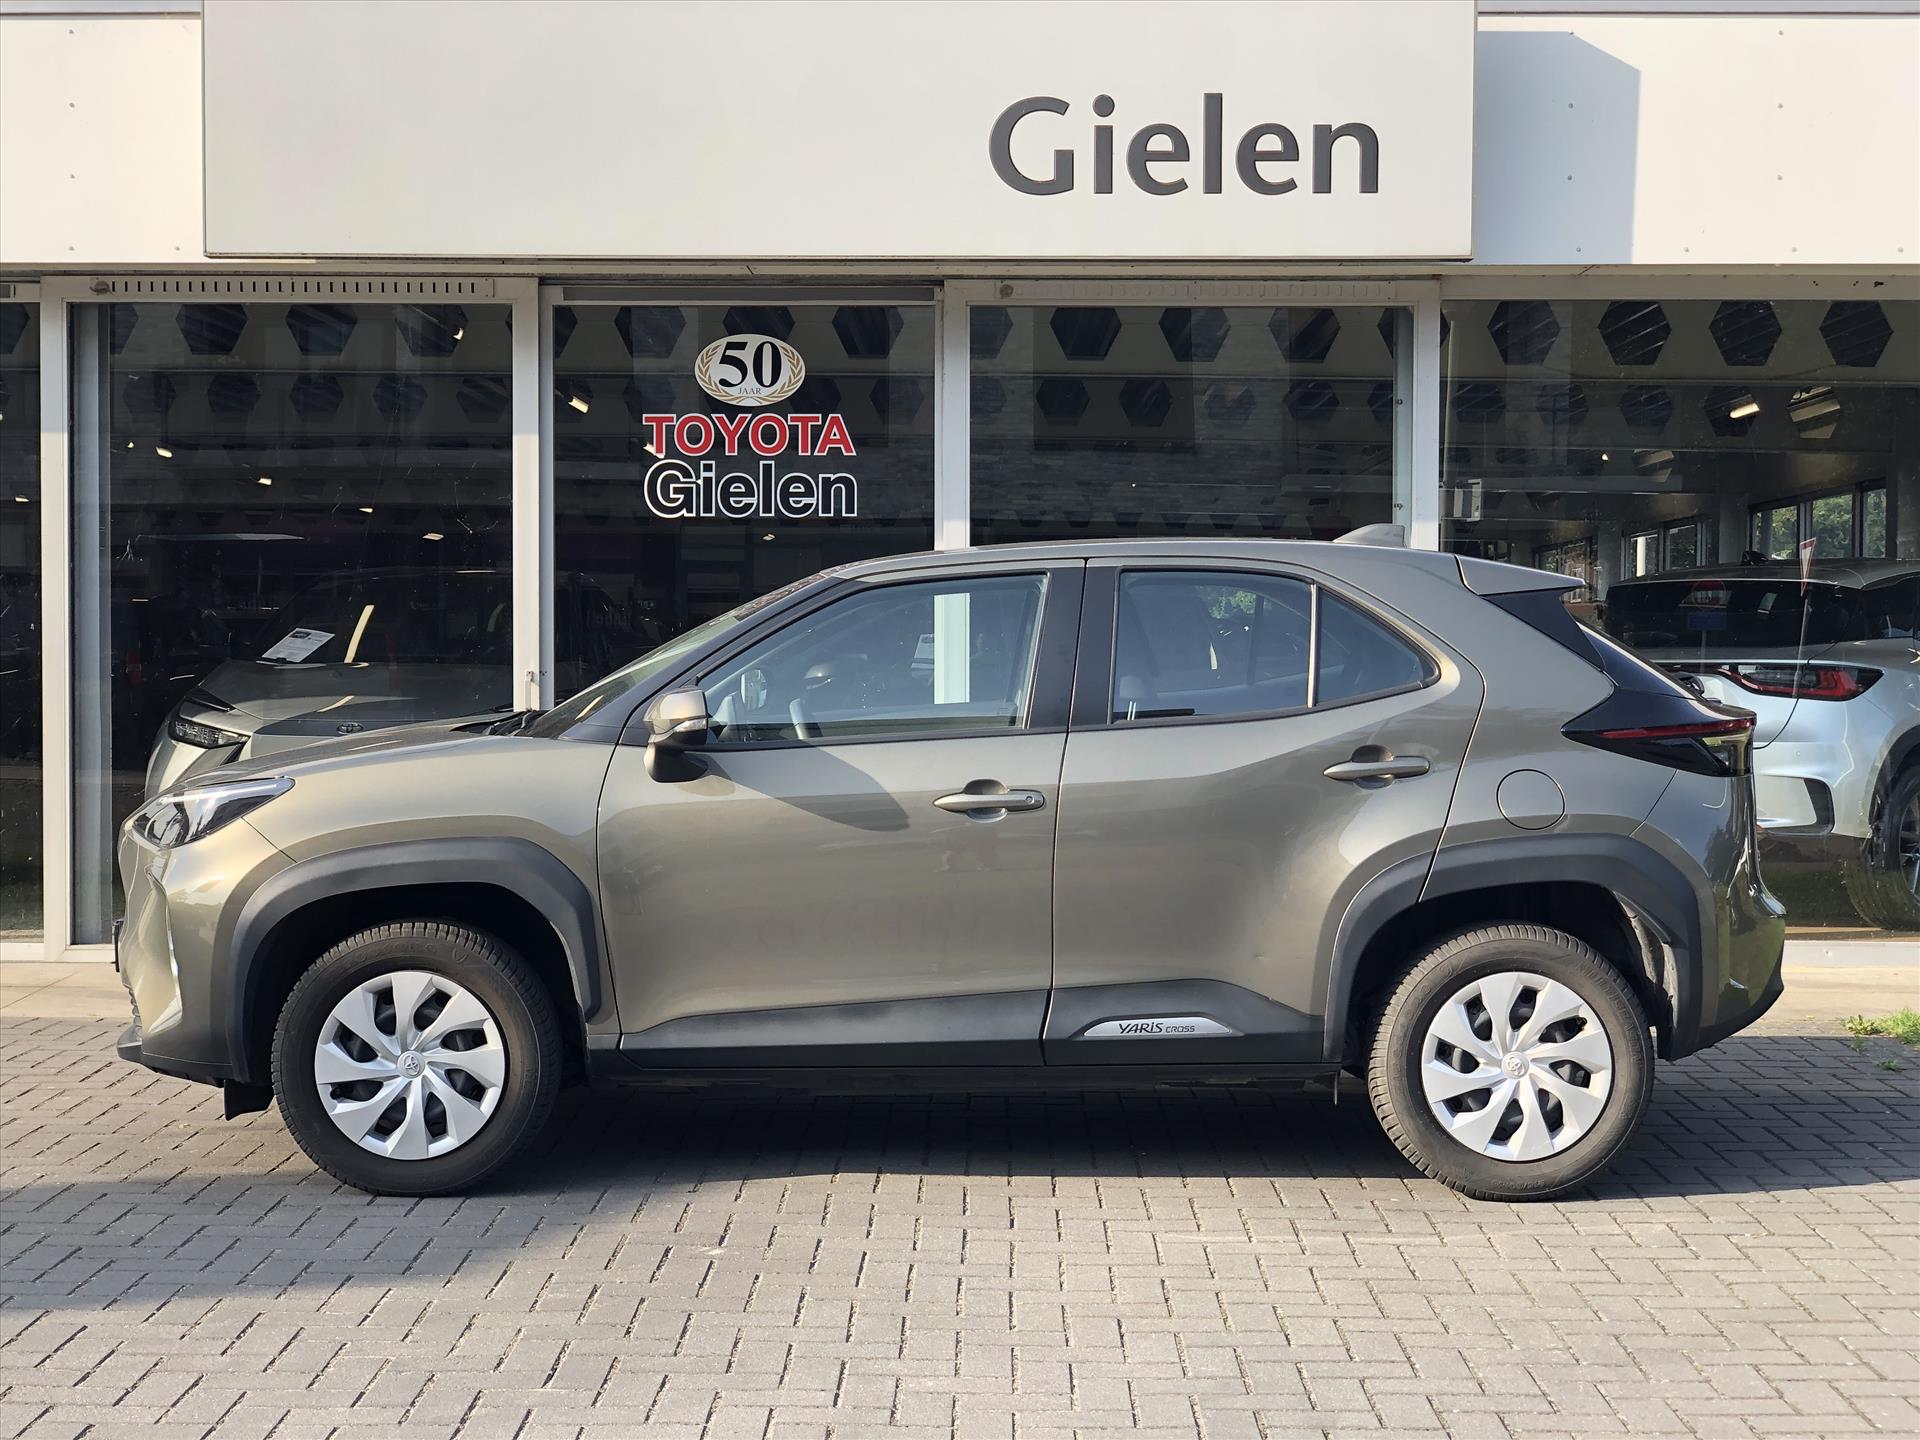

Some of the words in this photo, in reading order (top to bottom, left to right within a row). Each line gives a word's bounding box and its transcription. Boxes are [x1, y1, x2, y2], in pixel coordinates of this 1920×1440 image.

[988, 92, 1379, 196] Gielen
[718, 341, 783, 388] 50
[738, 387, 762, 395] JAAR
[642, 413, 857, 456] TOYOTA
[643, 459, 858, 518] Gielen
[1165, 1025, 1195, 1033] CROSS
